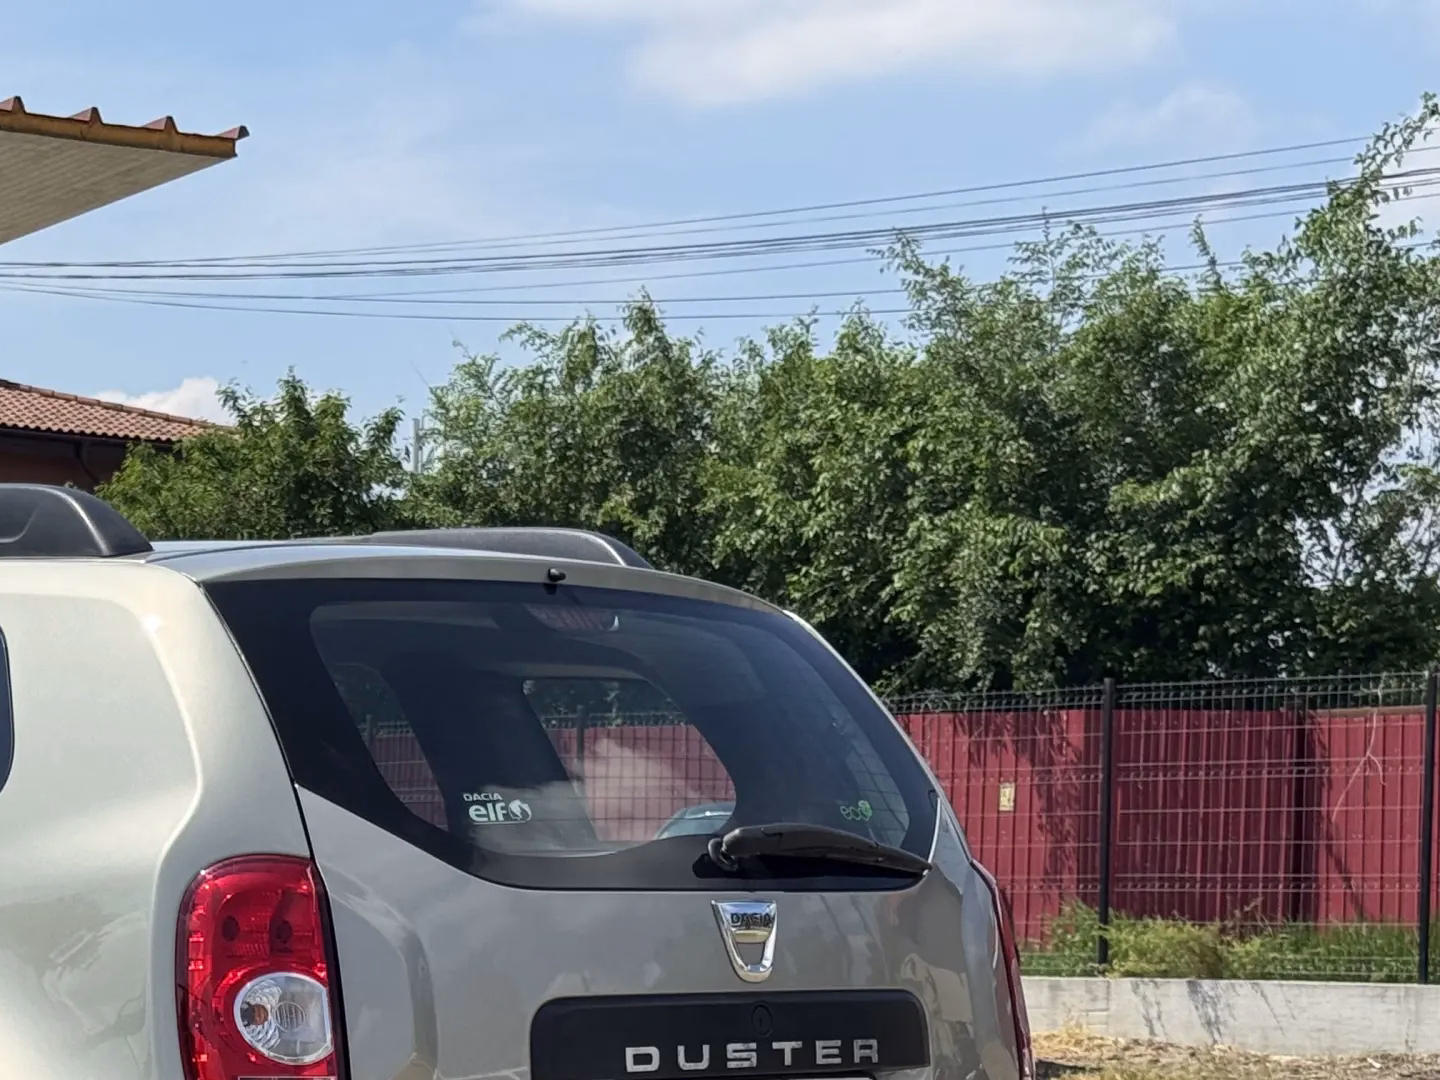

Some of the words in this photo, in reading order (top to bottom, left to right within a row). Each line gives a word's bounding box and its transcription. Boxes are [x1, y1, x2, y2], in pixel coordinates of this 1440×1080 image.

[462, 792, 503, 801] DACIA
[468, 802, 507, 822] elf
[730, 912, 772, 928] DACIA
[624, 1038, 880, 1073] DUSTER
